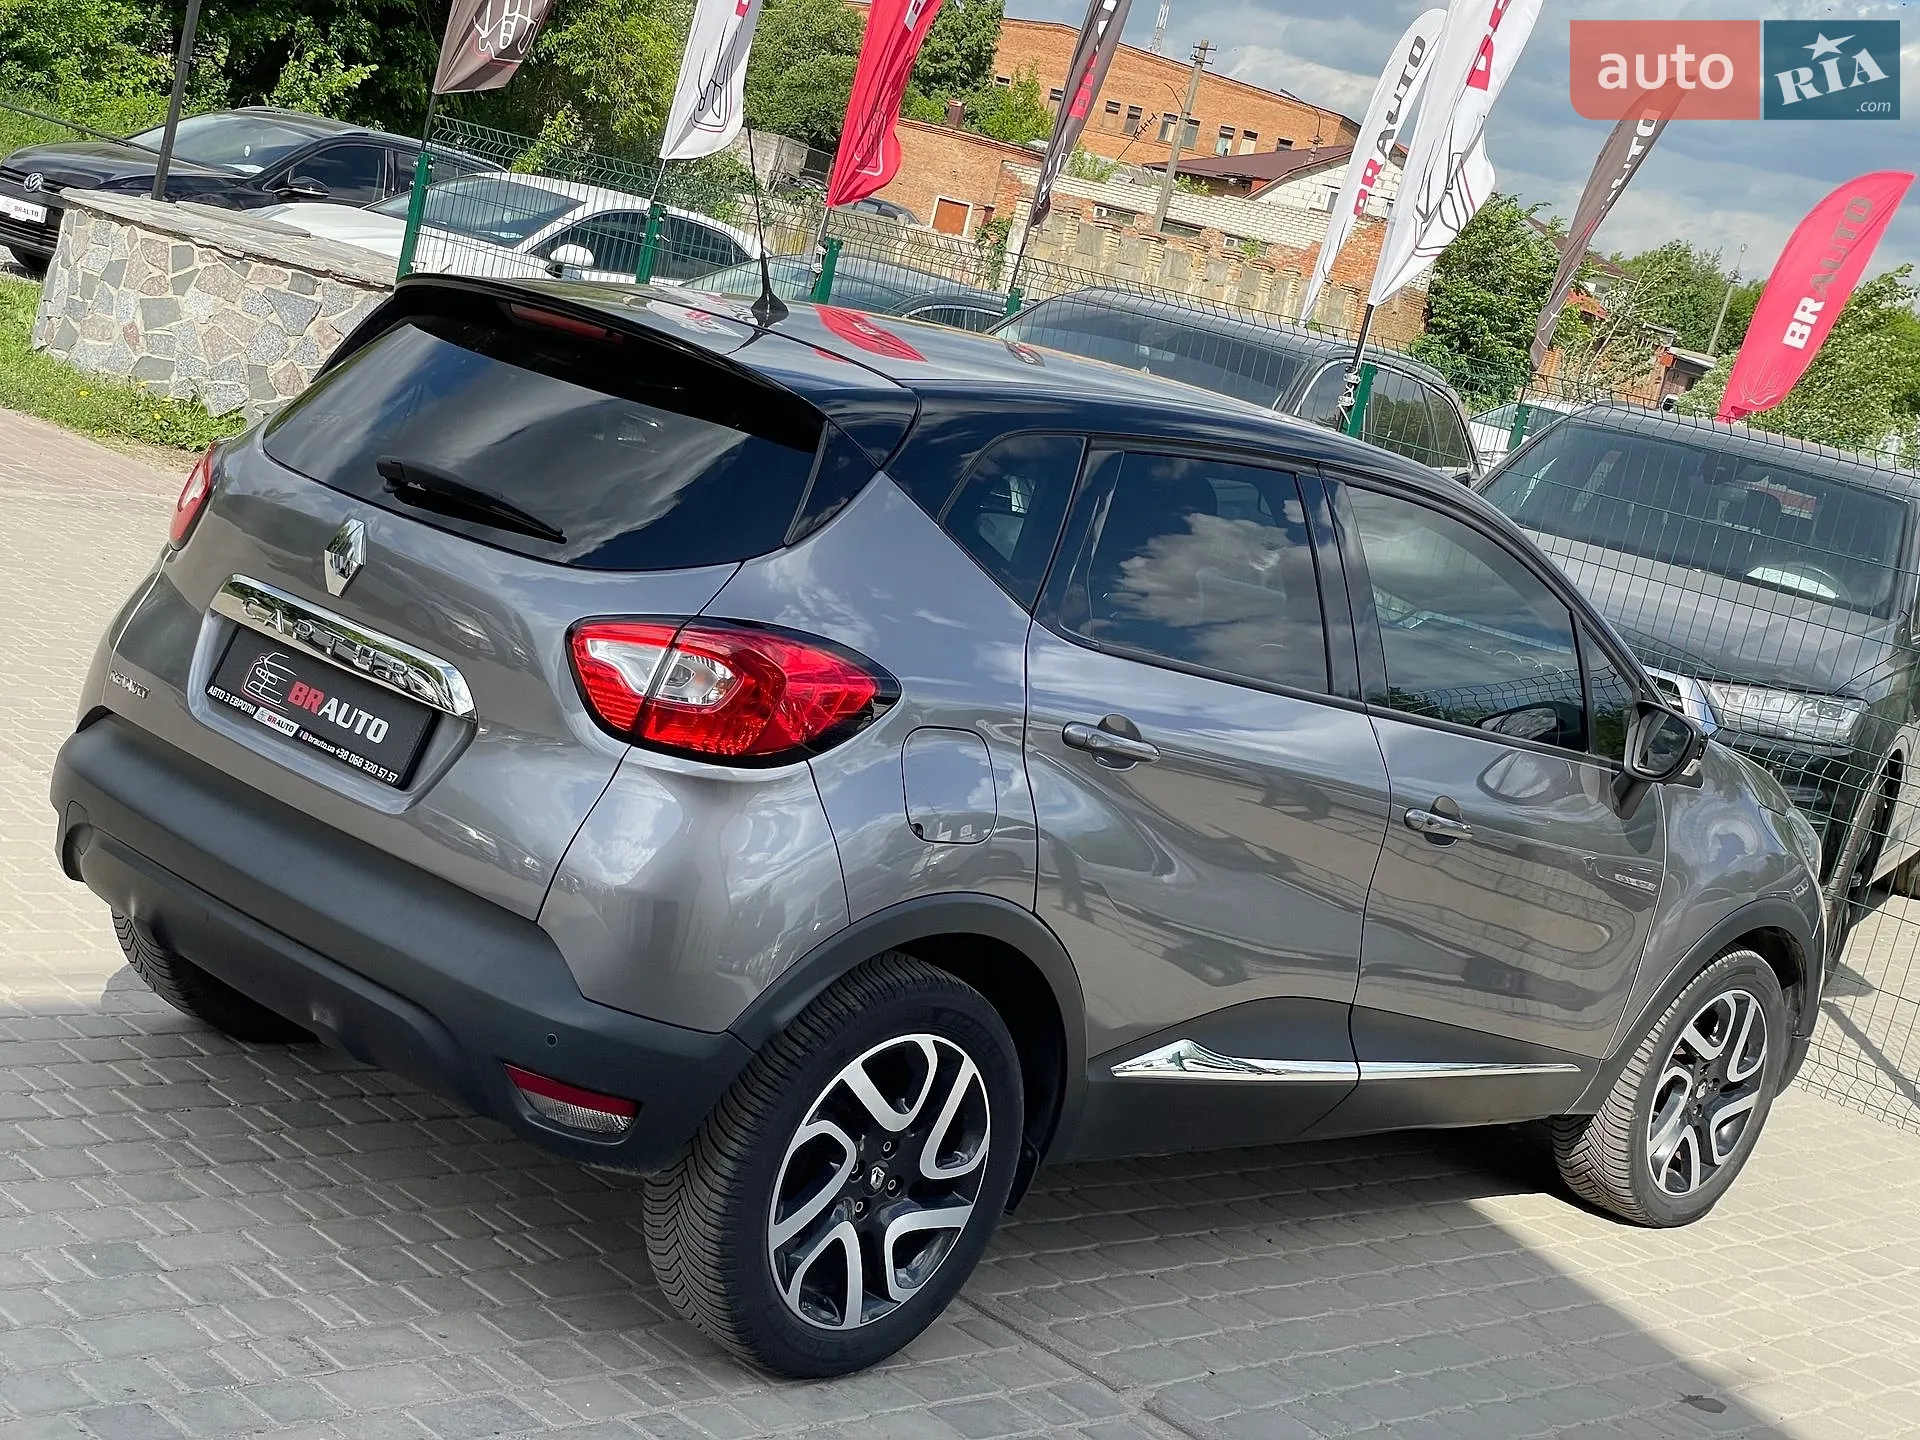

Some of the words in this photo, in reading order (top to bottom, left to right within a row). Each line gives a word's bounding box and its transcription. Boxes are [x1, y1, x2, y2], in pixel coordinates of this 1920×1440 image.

[1782, 196, 1873, 350] BRAUTO
[266, 714, 295, 733] BRAUTO
[287, 680, 389, 745] BRAUTO
[307, 733, 336, 753] brauto.ua
[335, 746, 350, 760] +38
[348, 753, 364, 768] 068
[362, 760, 379, 774] 320
[377, 767, 389, 779] 57
[386, 771, 399, 784] 57
